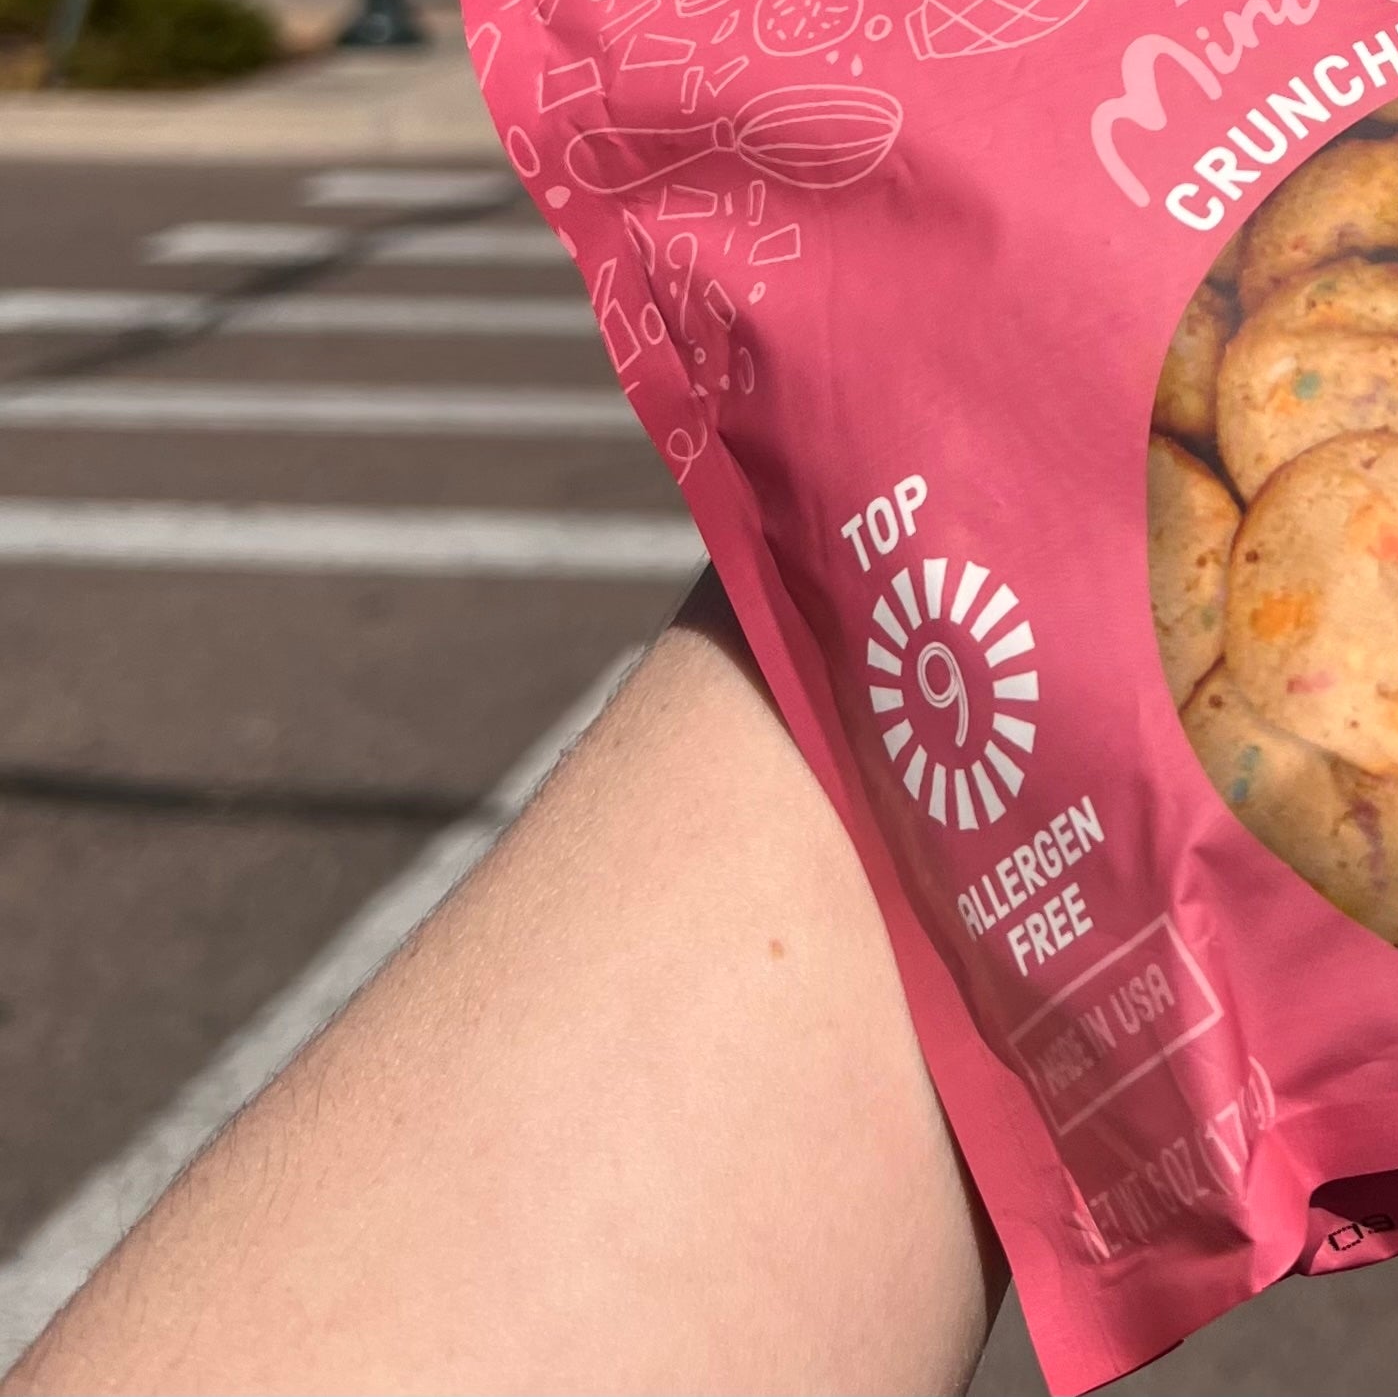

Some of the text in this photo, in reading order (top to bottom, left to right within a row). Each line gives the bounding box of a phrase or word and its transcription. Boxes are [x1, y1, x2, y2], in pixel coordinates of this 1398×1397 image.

[841, 474, 929, 572] TOP
[917, 641, 969, 747] 9
[957, 795, 1105, 942] ALLERGEN
[1006, 883, 1096, 977] FREE
[1077, 1004, 1118, 1059] IN
[1108, 962, 1176, 1035] USA
[1160, 1135, 1212, 1207] OZ
